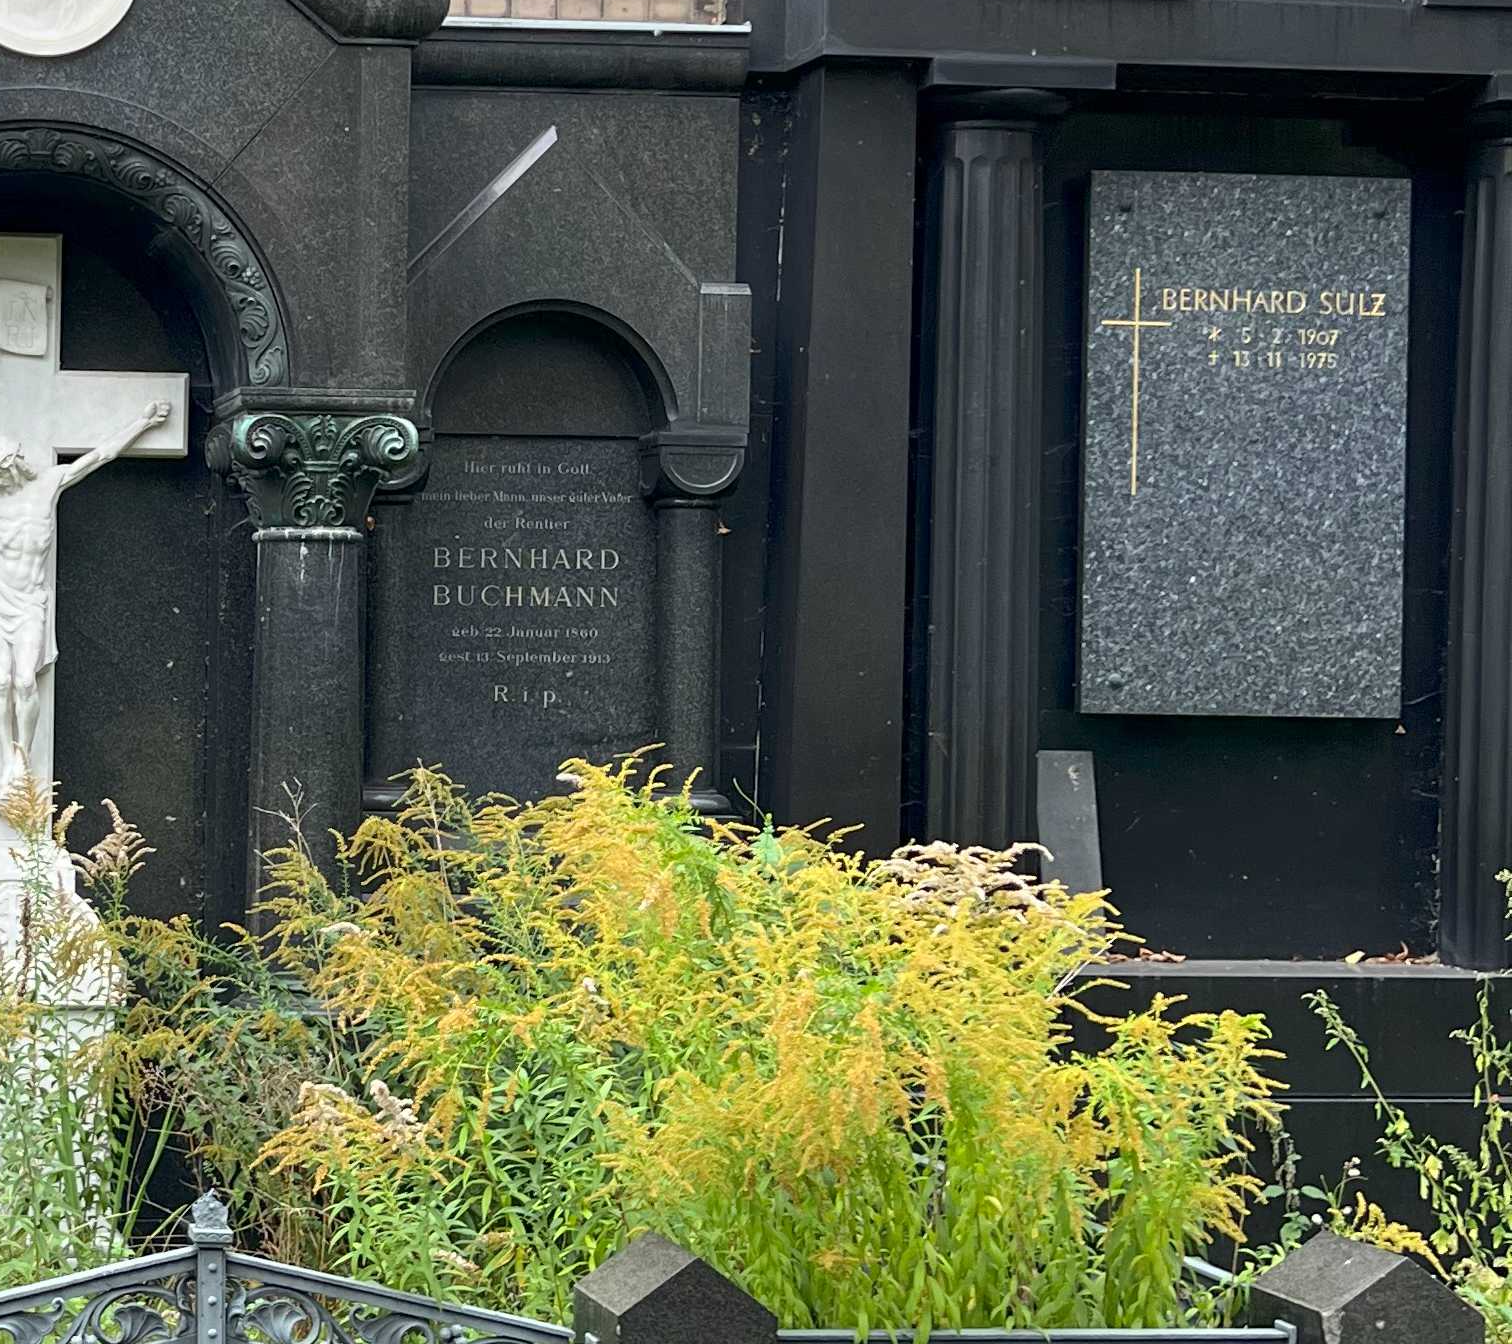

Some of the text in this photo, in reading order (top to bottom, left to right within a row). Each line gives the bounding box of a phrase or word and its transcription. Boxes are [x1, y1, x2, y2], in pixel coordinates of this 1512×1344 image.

[1162, 287, 1307, 314] BERNHARD
[464, 460, 591, 475] Hier ruht in Gott
[454, 490, 489, 502] lieber
[531, 492, 567, 504] unser
[568, 492, 599, 505] guter
[601, 492, 633, 504] Vater
[484, 516, 571, 531] der Rentier
[433, 546, 621, 571] BERNHARD
[432, 583, 620, 608] BUCHMANN
[506, 625, 561, 639] Januar
[565, 627, 599, 639] 1860
[496, 649, 577, 666] September
[582, 653, 611, 665] 1913
